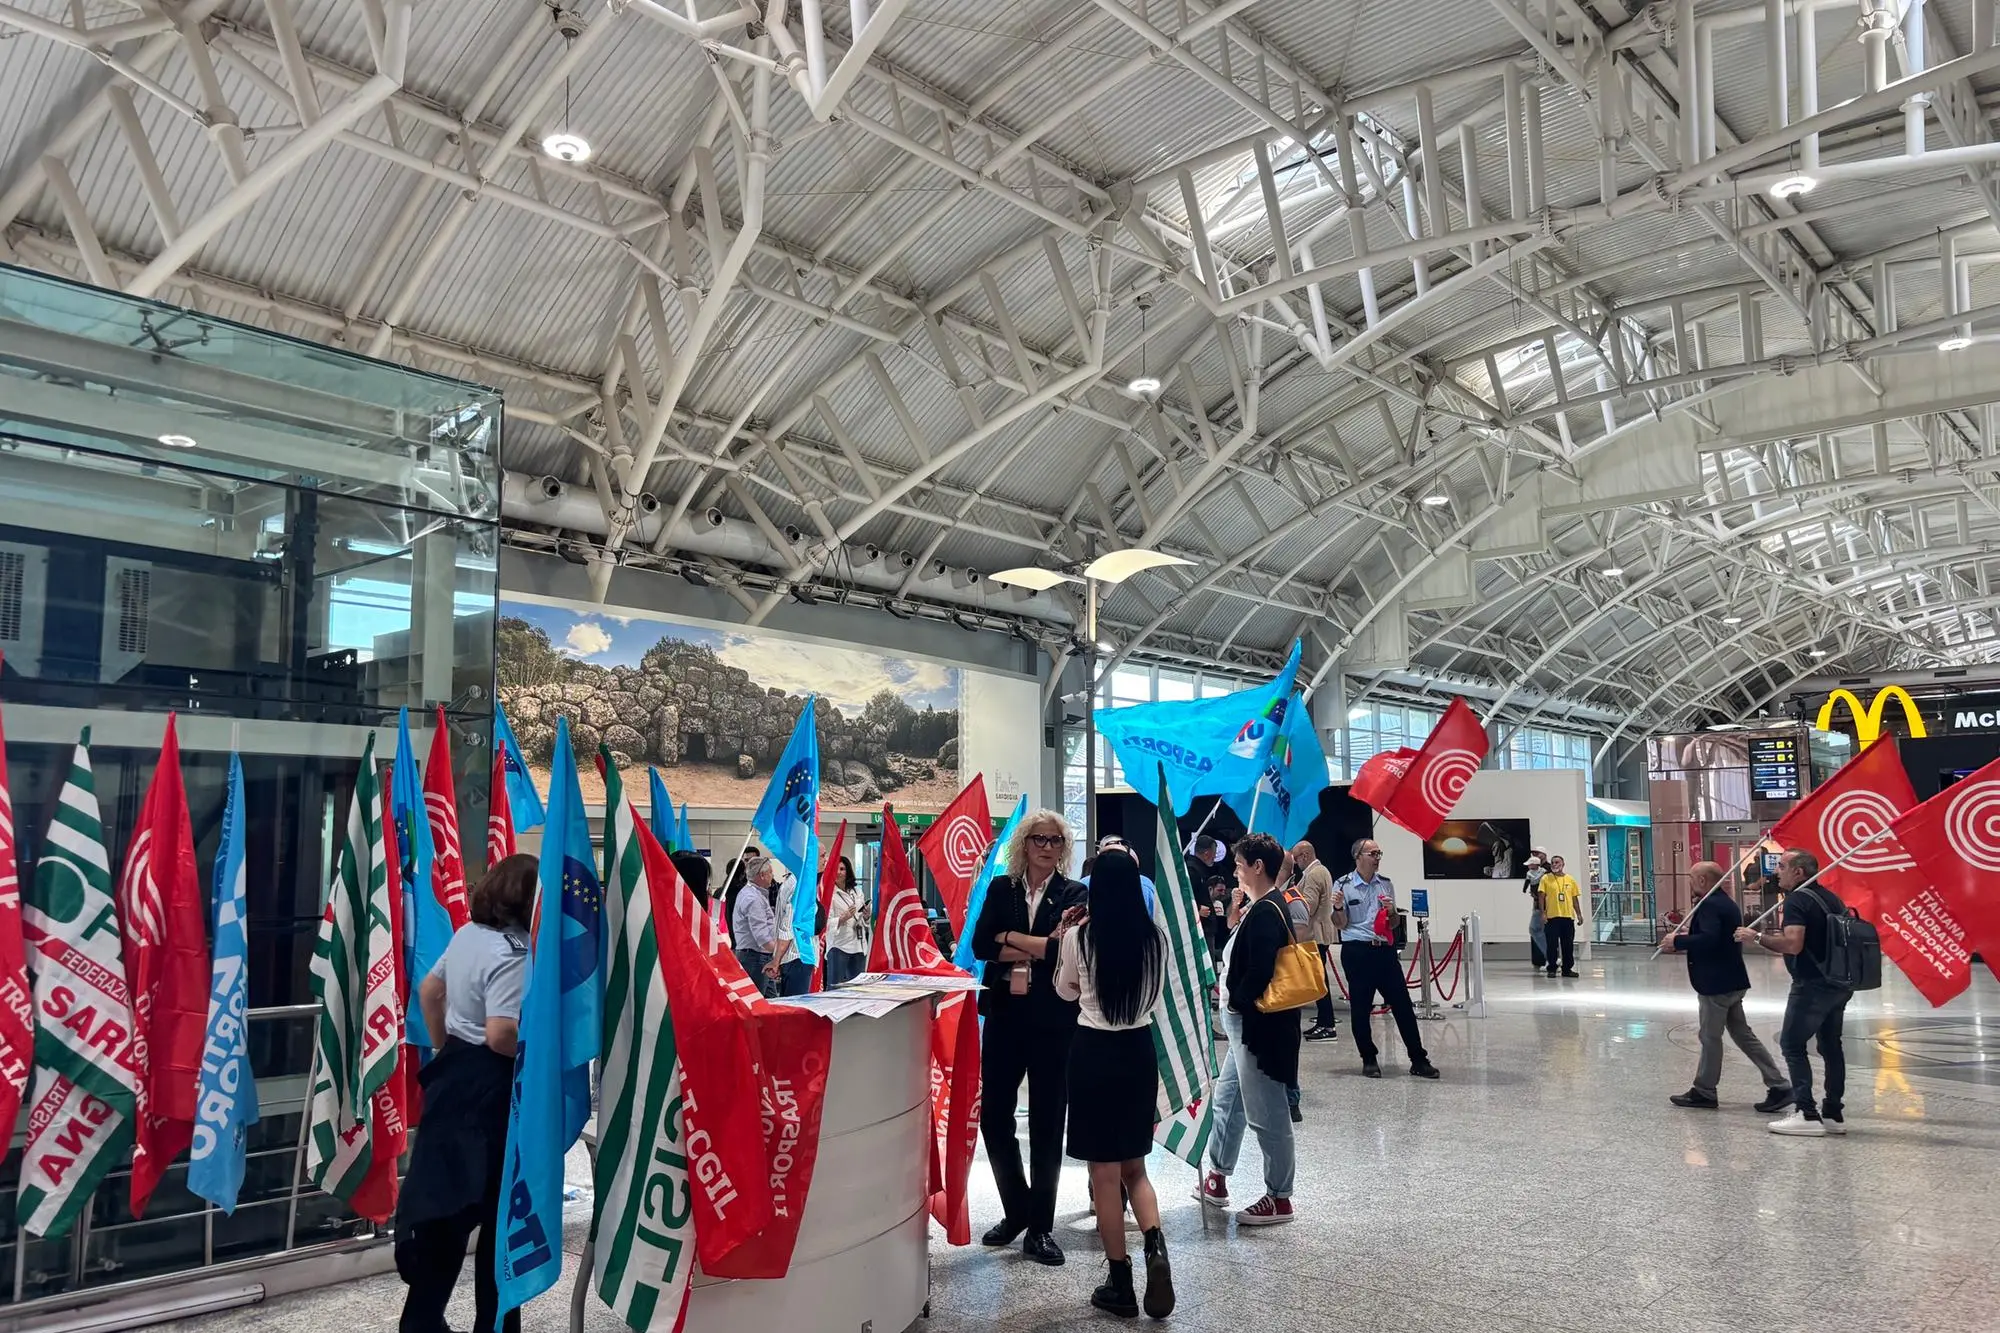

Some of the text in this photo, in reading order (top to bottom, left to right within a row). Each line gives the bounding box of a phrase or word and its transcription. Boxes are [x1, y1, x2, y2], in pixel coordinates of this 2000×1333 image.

[1955, 711, 2000, 728] Mc
[907, 814, 919, 824] Exit
[1898, 906, 1954, 964] TRASPORTI
[1907, 899, 1971, 964] LAVORATORI
[1918, 890, 1965, 942] ITALIANA
[1881, 912, 1954, 979] CAGLIARI
[59, 948, 130, 1006] FEDERAZI
